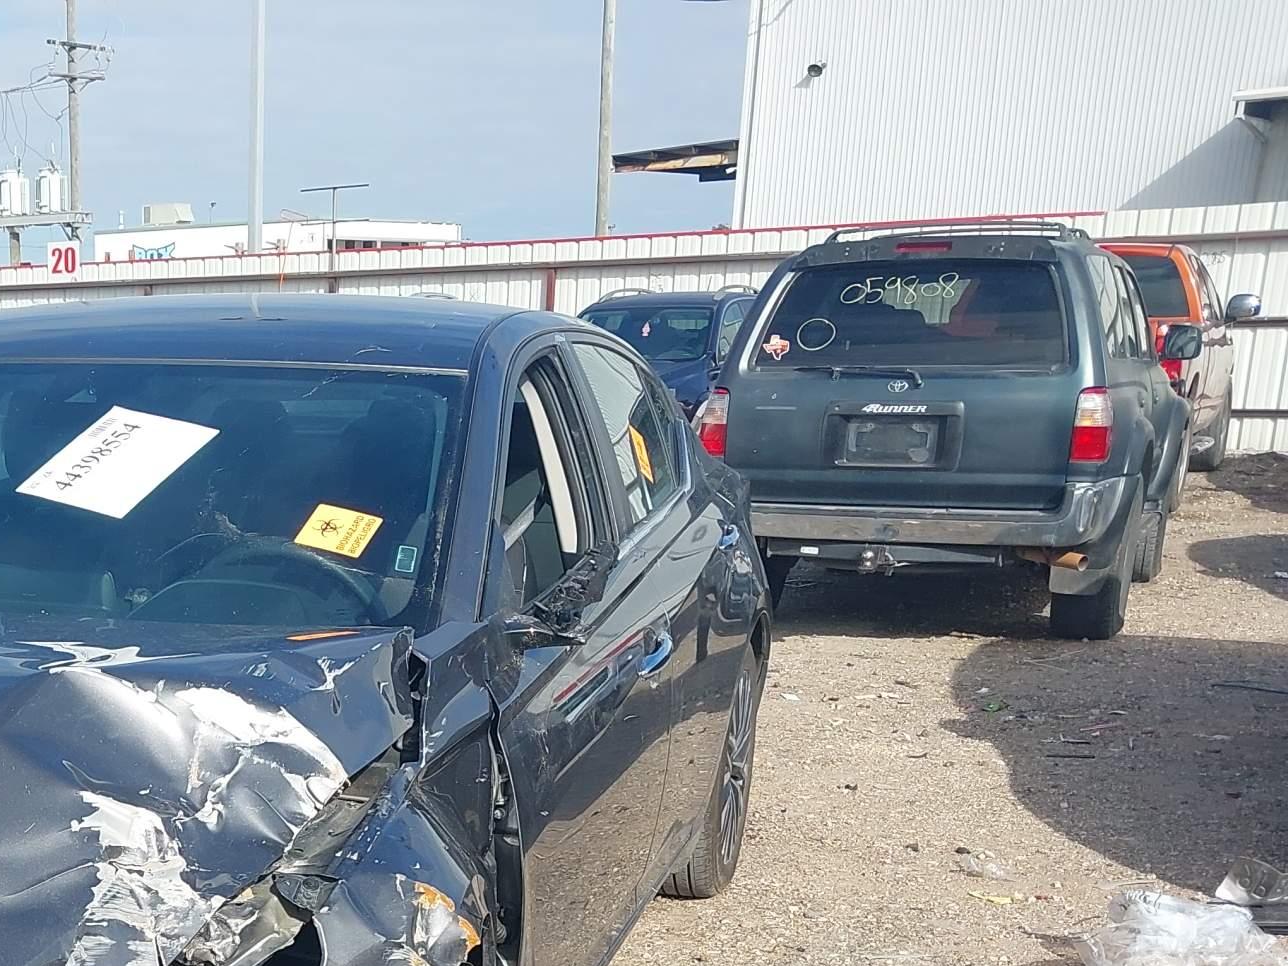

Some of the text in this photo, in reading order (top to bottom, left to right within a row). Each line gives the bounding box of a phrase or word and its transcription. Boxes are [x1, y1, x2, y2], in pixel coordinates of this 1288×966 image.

[51, 247, 77, 274] 20
[840, 272, 959, 305] 059808
[55, 421, 142, 491] 44398554
[335, 515, 365, 551] BIOHAZARD
